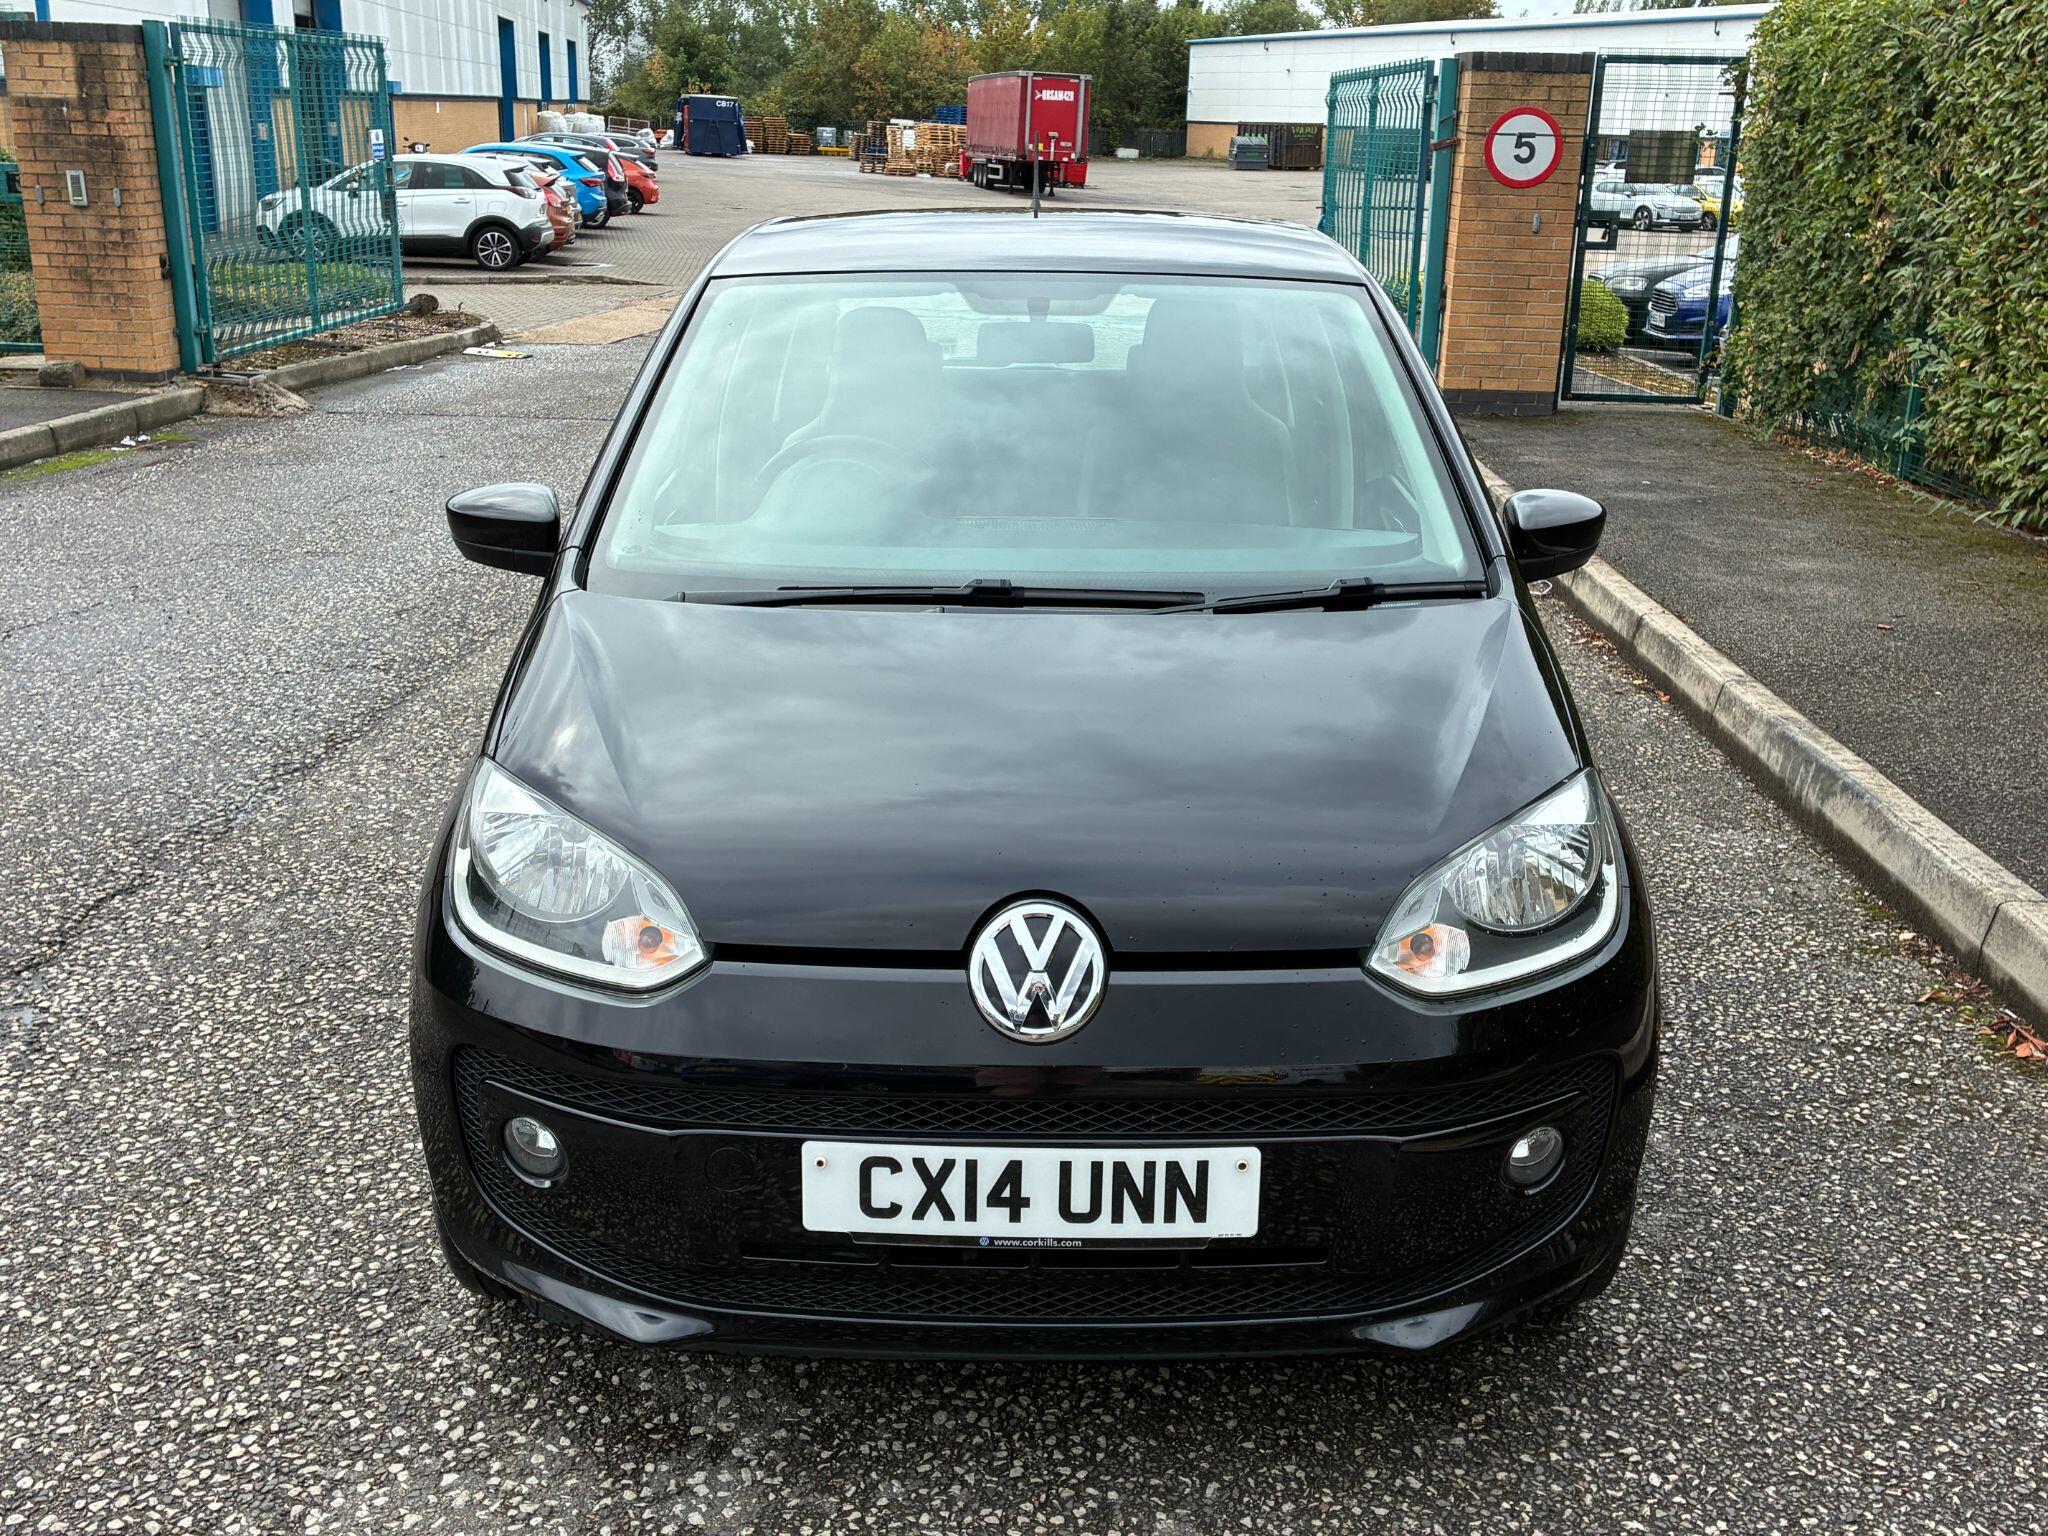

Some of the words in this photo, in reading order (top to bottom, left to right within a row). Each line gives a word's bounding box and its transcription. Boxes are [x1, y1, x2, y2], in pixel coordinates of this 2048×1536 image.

[1513, 132, 1537, 164] 5
[974, 904, 1100, 1039] VW
[859, 1156, 1031, 1224] CX14
[1058, 1159, 1210, 1225] UNN
[993, 1238, 1082, 1247] www.corkills.com
